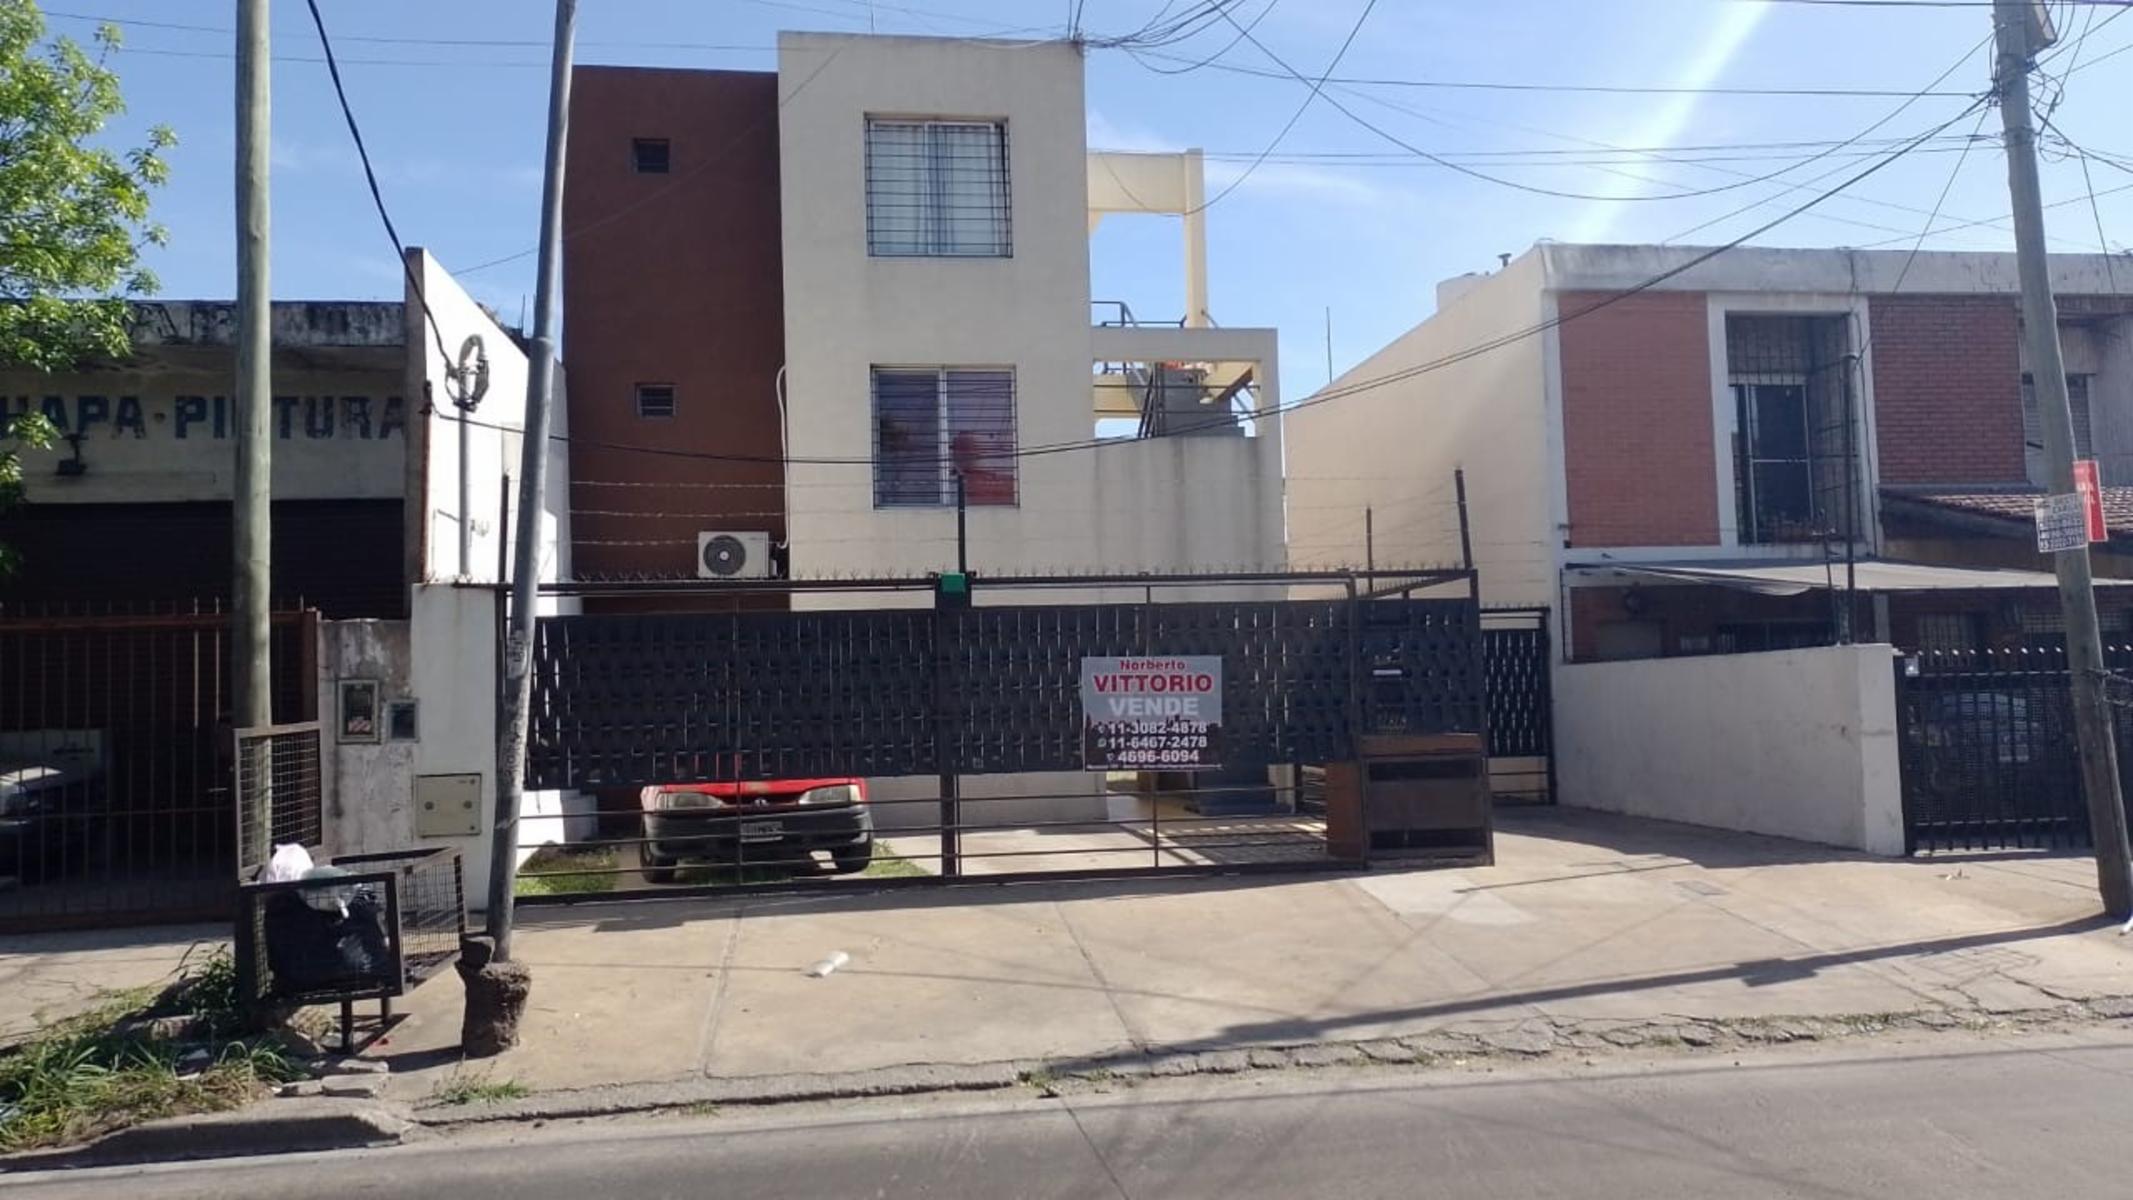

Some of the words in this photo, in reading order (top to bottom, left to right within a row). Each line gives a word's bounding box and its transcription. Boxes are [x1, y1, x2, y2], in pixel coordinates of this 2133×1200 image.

[174, 395, 404, 440] PITURA
[1119, 659, 1186, 671] Norberto
[1093, 674, 1213, 693] VITTORIO
[1108, 697, 1200, 716] VENDE
[1109, 736, 1208, 748] 11-6467-2478
[1117, 750, 1200, 763] 4696-6094
